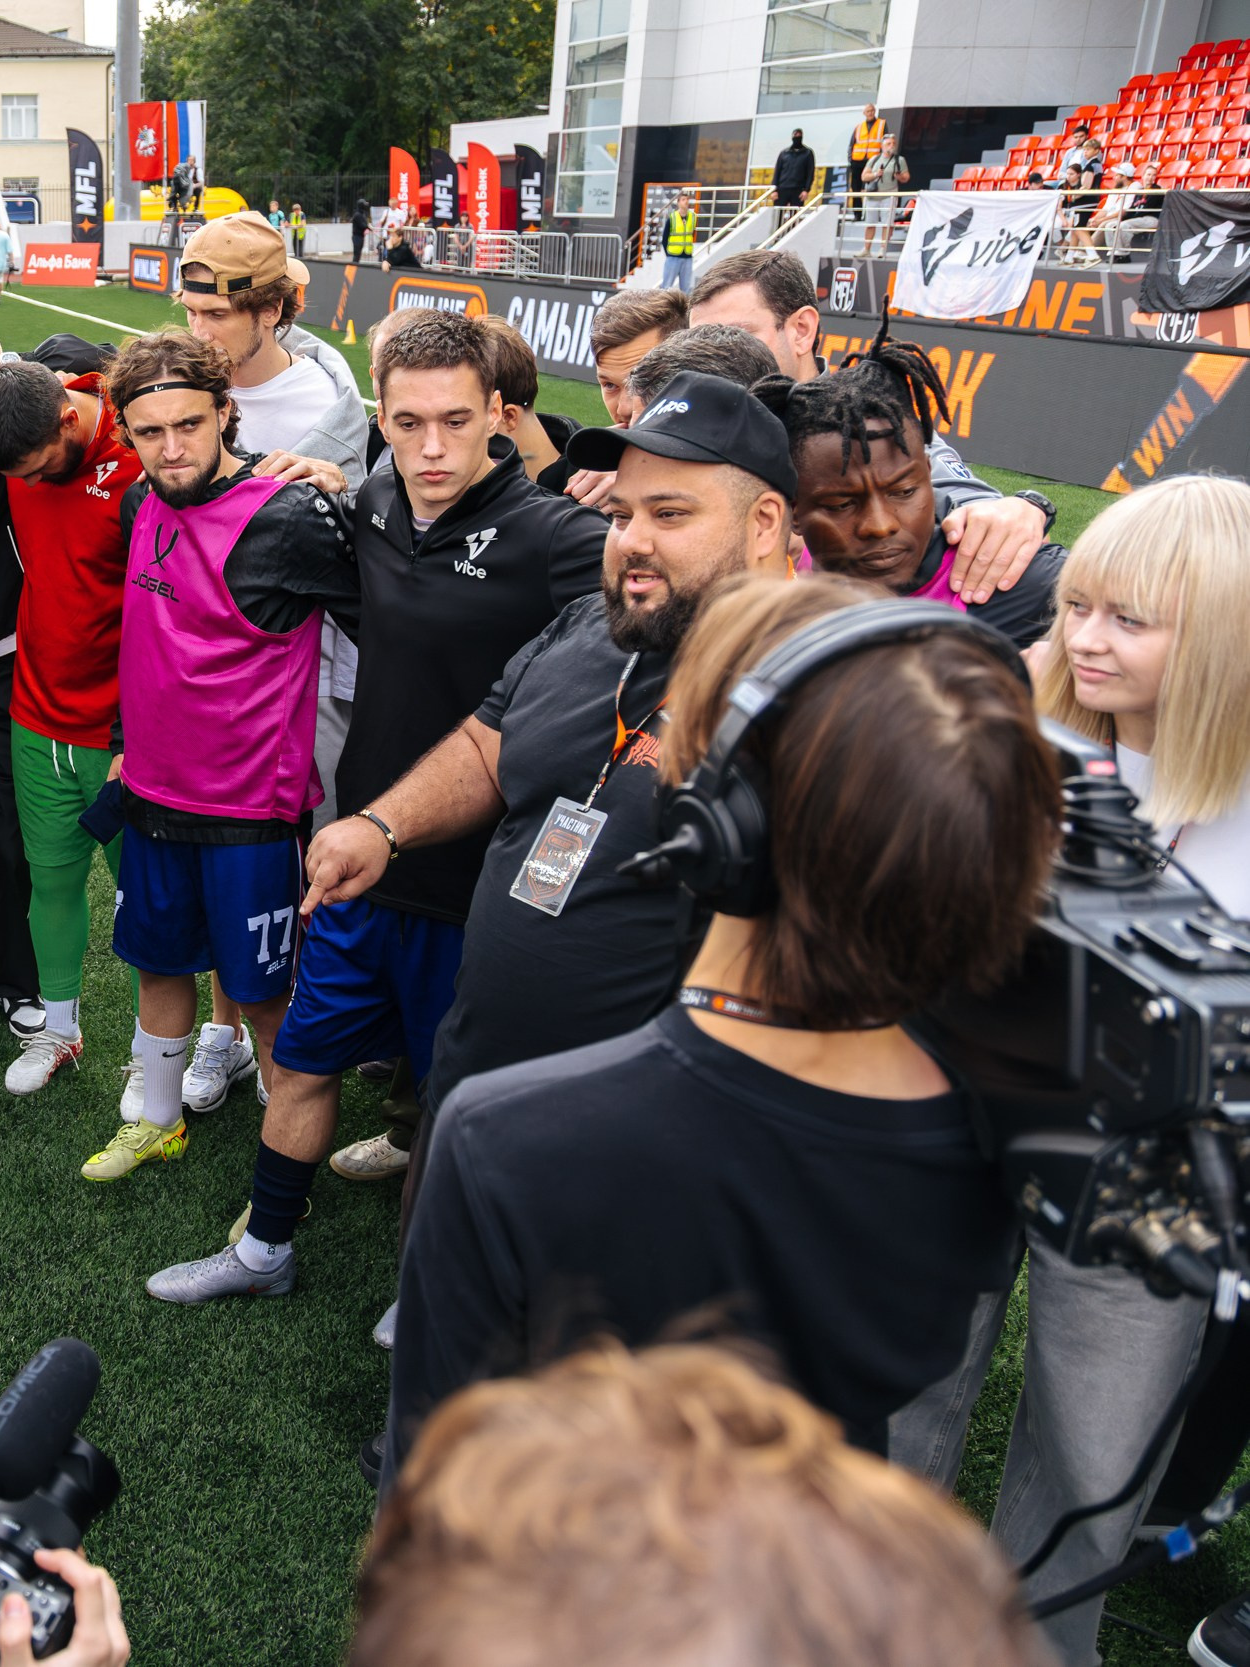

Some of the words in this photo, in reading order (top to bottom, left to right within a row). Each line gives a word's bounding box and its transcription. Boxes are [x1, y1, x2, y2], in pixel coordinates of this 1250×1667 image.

[75, 161, 97, 216] MFL
[434, 173, 453, 220] MFL
[475, 167, 488, 200] Банк
[520, 171, 541, 221] MFL
[27, 253, 63, 272] Альфа
[64, 253, 91, 270] Банк
[966, 225, 1044, 269] vibe
[1131, 389, 1196, 478] WIN
[85, 484, 111, 500] vibe
[131, 569, 180, 603] JÖGEL
[453, 560, 487, 579] vibe
[554, 813, 591, 837] УЧАСТНИК
[247, 905, 294, 964] 77
